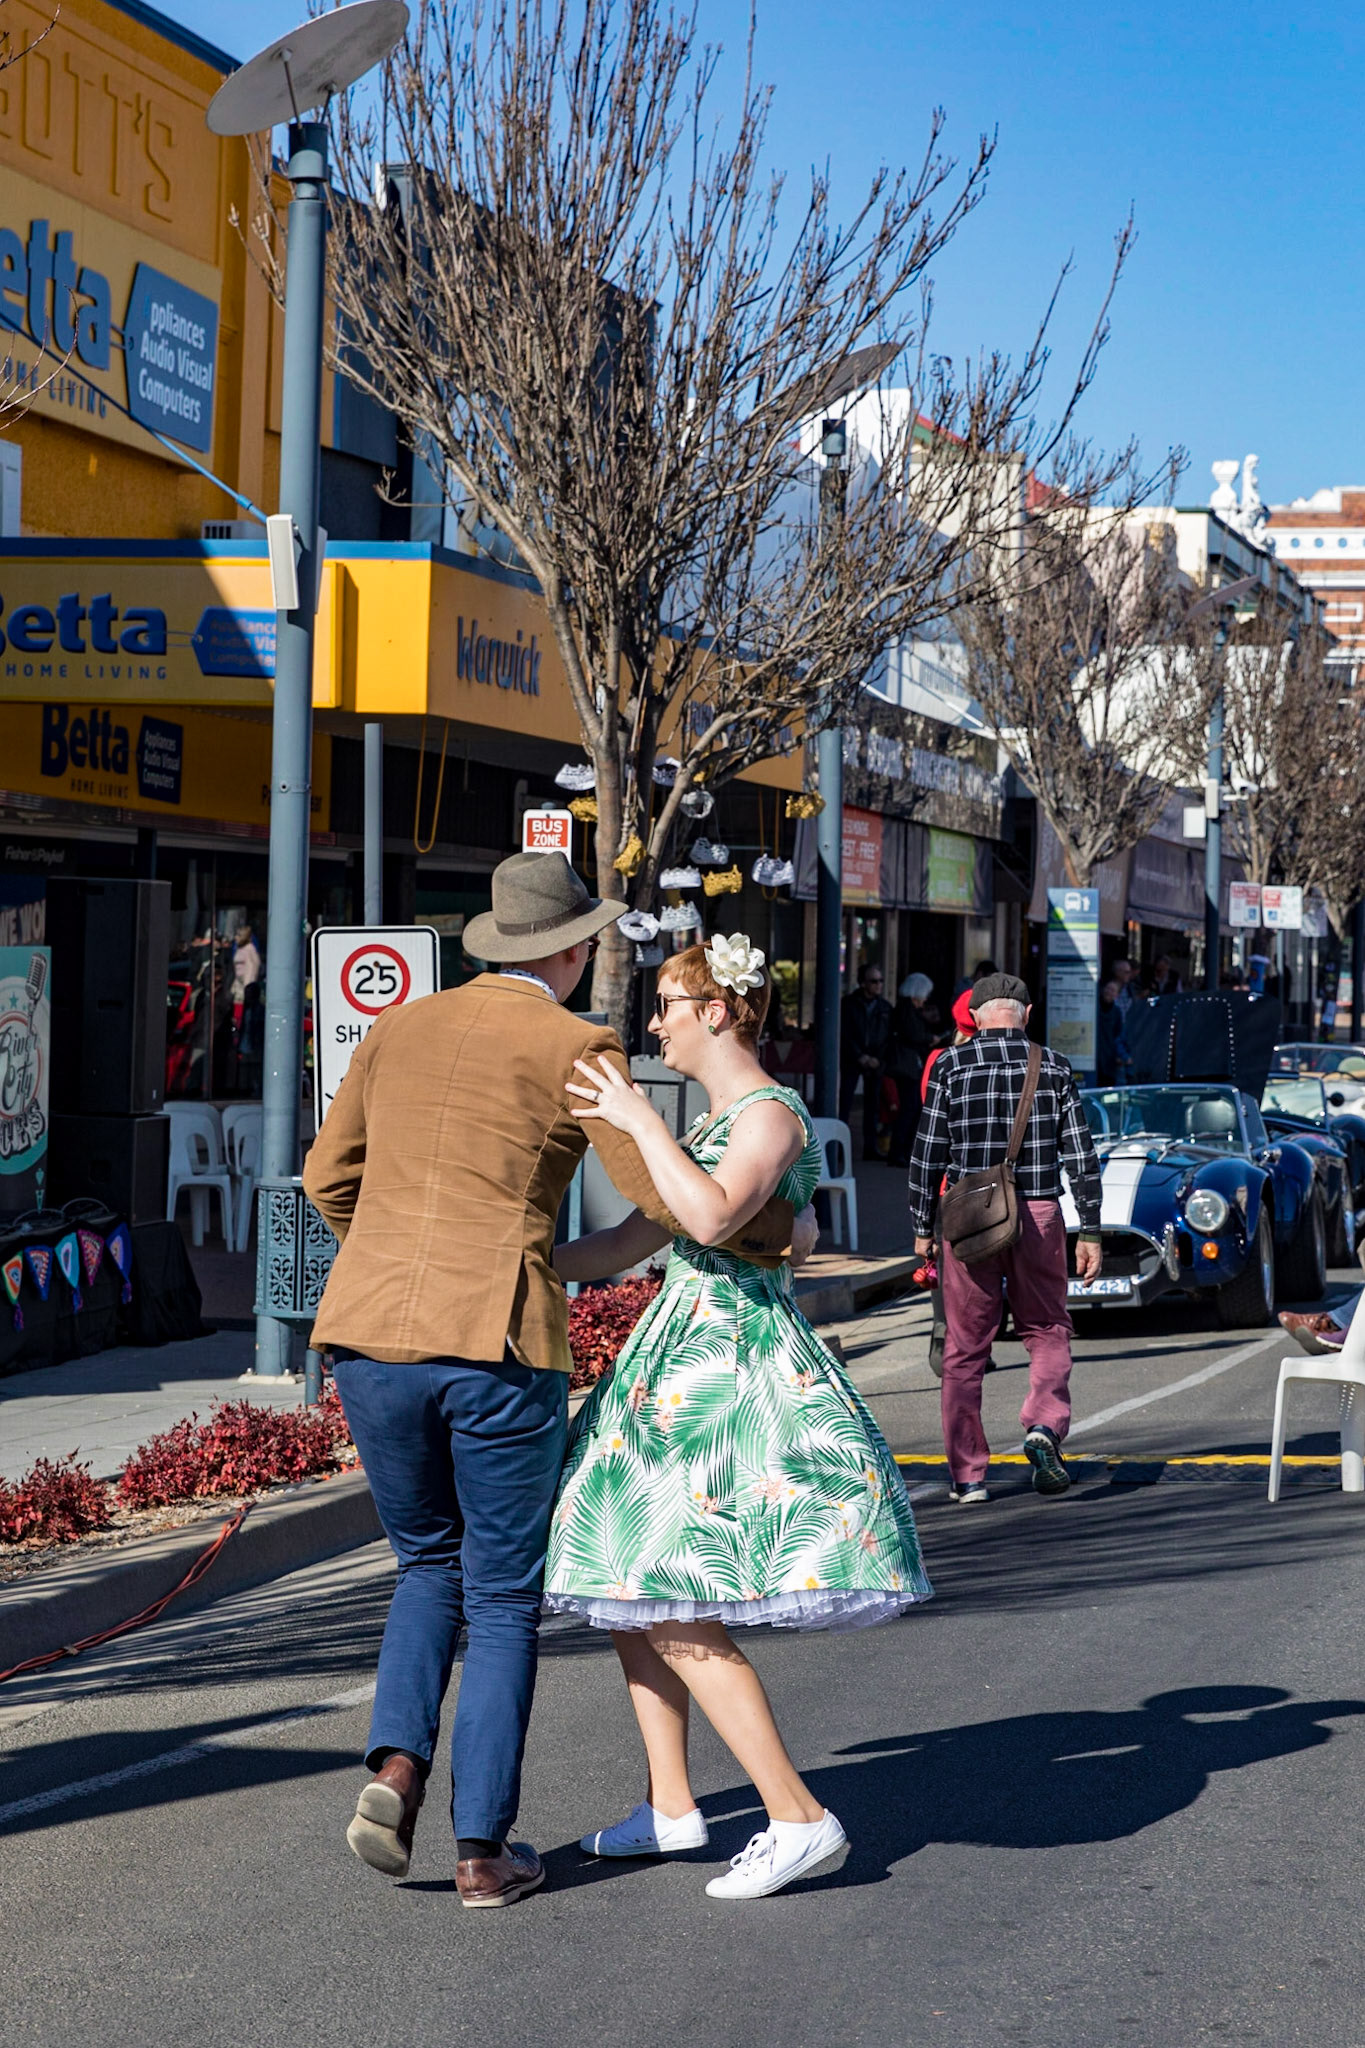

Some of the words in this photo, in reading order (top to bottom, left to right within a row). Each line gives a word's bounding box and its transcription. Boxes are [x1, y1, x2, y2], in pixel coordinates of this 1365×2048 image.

[140, 330, 175, 375] Audio
[177, 347, 213, 392] Visual
[50, 376, 107, 419] LIVING
[138, 367, 201, 425] Computers
[457, 616, 542, 696] Warwick
[6, 664, 68, 678] HOME
[85, 665, 168, 680] LIVING
[40, 704, 130, 778] Betta
[144, 729, 177, 752] Appliances
[143, 749, 162, 767] Audio
[161, 756, 180, 771] Visual
[70, 778, 95, 795] HOME
[98, 783, 129, 799] LIVING
[143, 768, 174, 789] Computers
[531, 820, 563, 833] BUS
[533, 833, 562, 847] ZONE
[355, 965, 397, 994] 25
